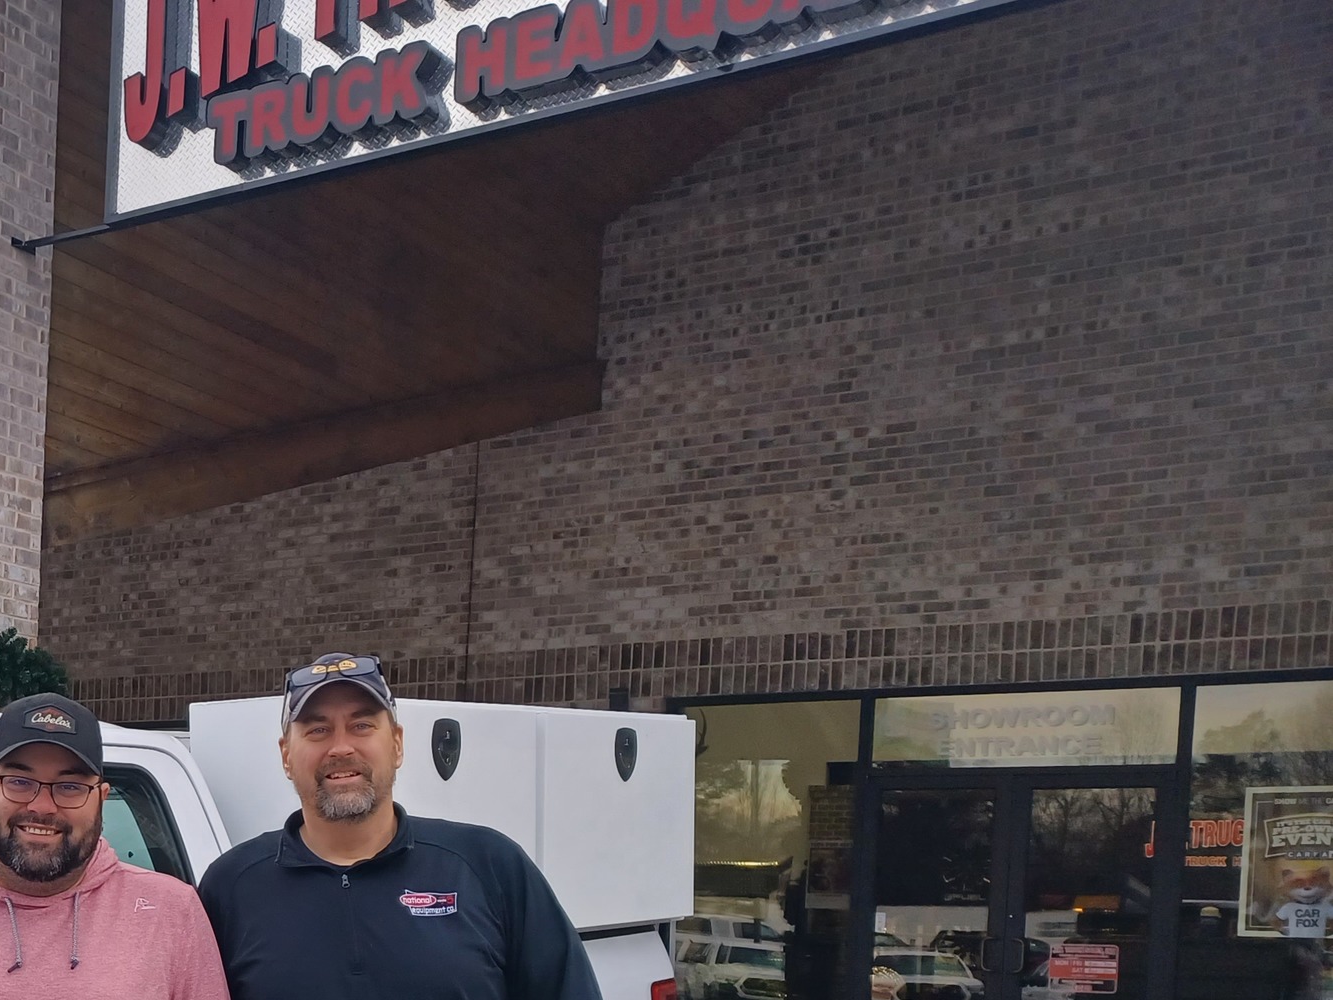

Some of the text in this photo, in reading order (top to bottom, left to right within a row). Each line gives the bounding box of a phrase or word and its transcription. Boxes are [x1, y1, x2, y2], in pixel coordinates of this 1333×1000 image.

[208, 42, 430, 160] TRUCK
[31, 712, 72, 729] Cabela's
[931, 704, 1115, 731] SHOWROOM
[939, 734, 1103, 758] ENTRANCE
[1189, 819, 1244, 849] TRUC
[1272, 824, 1333, 835] PRE-OWN
[1271, 832, 1333, 848] EVEN
[1295, 909, 1320, 918] CAR
[1296, 919, 1319, 928] FOX
